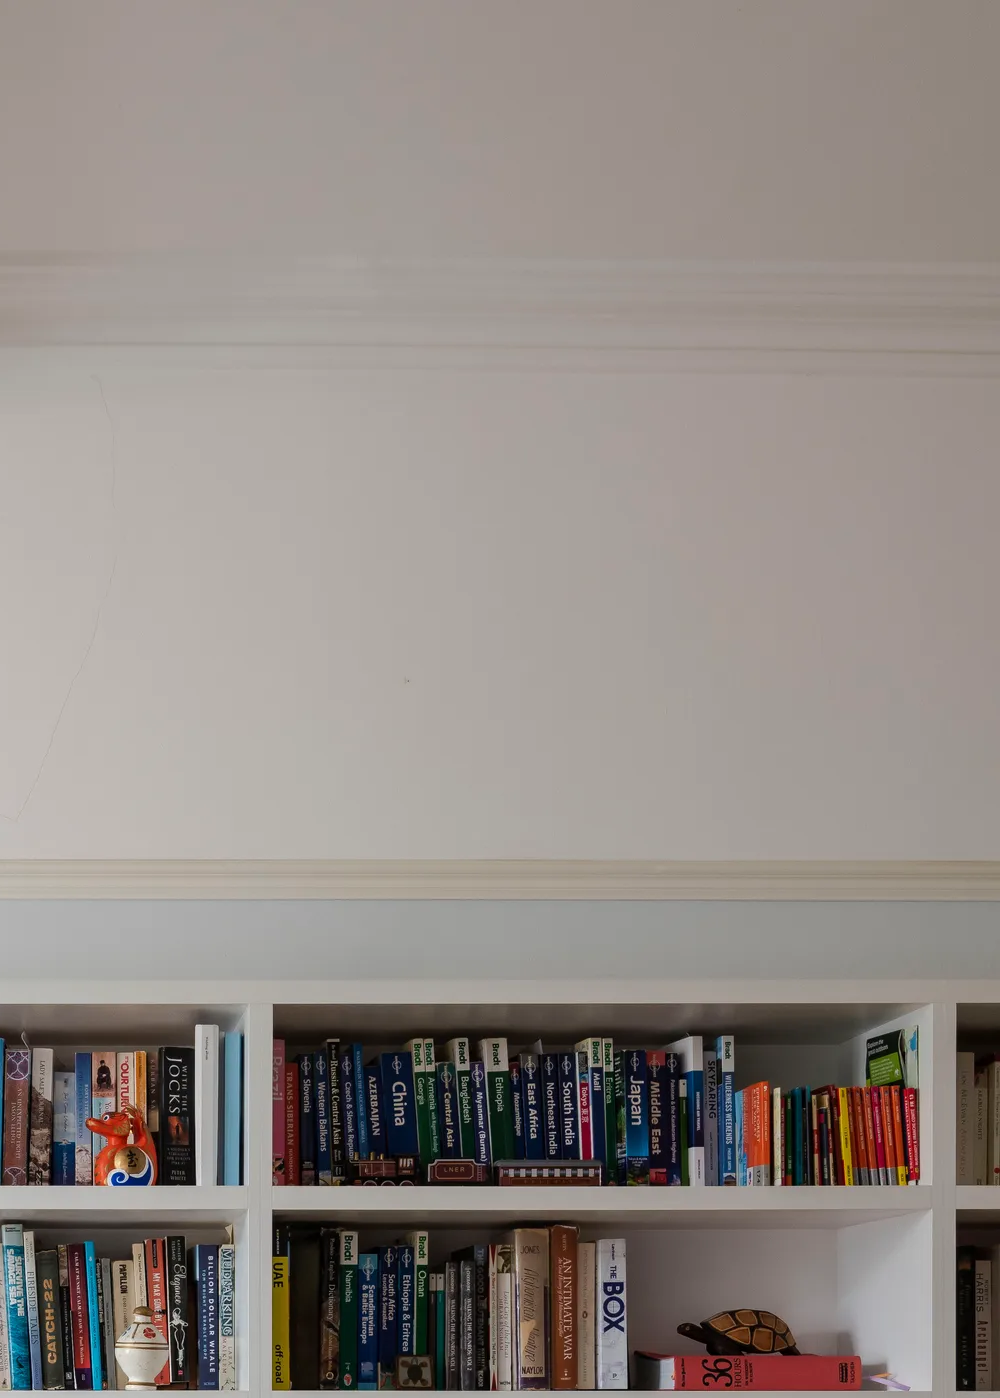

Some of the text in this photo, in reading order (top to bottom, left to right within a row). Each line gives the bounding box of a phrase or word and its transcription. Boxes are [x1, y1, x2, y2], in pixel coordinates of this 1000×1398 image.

[414, 1043, 422, 1066] Bradt
[458, 1041, 471, 1123] Bradt Bangladesh
[492, 1043, 504, 1112] Bradt Ethiopia
[592, 1041, 601, 1091] Bradt Mali
[165, 1056, 182, 1113] JOCKS
[303, 1079, 311, 1113] Slovenia
[368, 1075, 380, 1136] AZERBAIJAN
[392, 1081, 407, 1127] China
[527, 1083, 538, 1139] East Africa
[627, 1075, 645, 1126] Japan
[707, 1060, 716, 1119] SKYFARING
[318, 1081, 327, 1152] Western Balkans
[444, 1092, 454, 1148] Central Asia
[475, 1091, 487, 1162] Myanmar (Burma)
[546, 1082, 557, 1155] Northeast India
[562, 1081, 575, 1146] South India
[581, 1108, 589, 1124] 東京
[650, 1081, 661, 1155] Middle East
[15, 1256, 24, 1297] SURVIVE
[170, 1263, 186, 1305] Elegance
[344, 1235, 353, 1302] Bradt Namibia
[401, 1274, 410, 1311] Ethiopia
[418, 1236, 426, 1297] Bradt Oman
[43, 1279, 57, 1364] CATCH-22
[273, 1262, 283, 1383] UAE off-road
[563, 1257, 572, 1360] AN INTIMATE WAR
[603, 1282, 624, 1333] BOX
[402, 1323, 411, 1352] Eritrea
[976, 1321, 988, 1372] Archangel
[702, 1357, 733, 1388] 36
